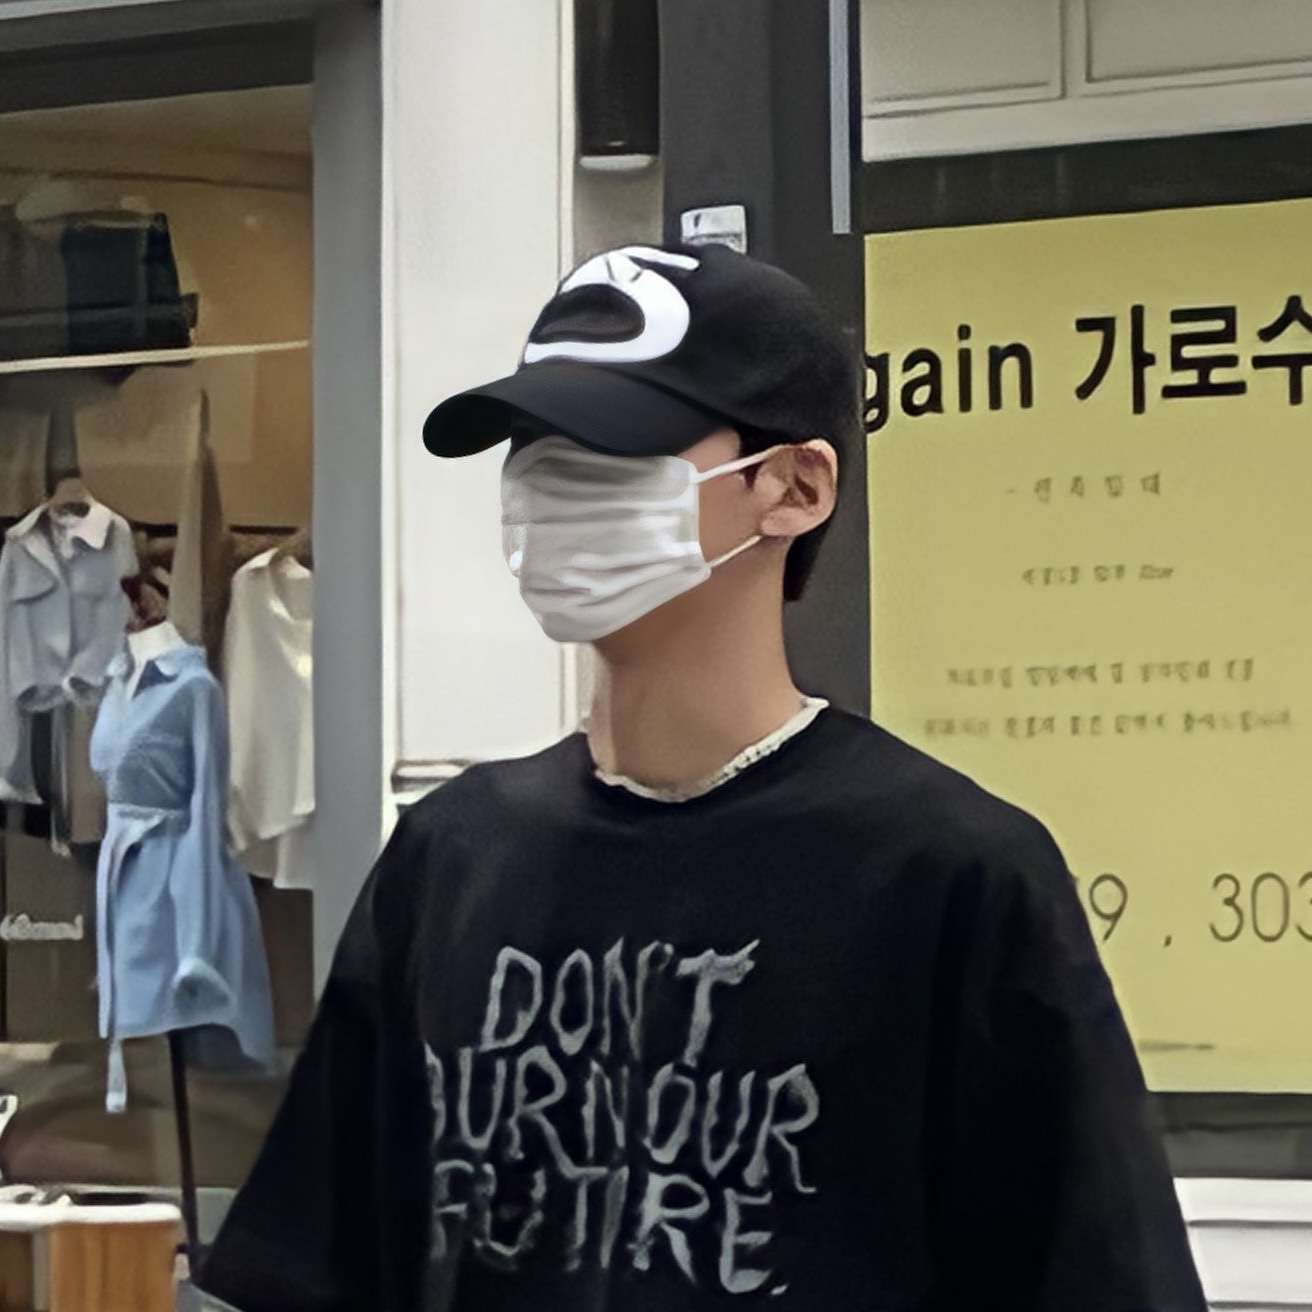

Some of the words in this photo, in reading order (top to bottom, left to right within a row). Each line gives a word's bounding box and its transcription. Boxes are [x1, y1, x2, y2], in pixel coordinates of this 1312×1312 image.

[479, 936, 760, 1067] DON'T
[424, 1040, 630, 1180] URN
[644, 1062, 821, 1194] OUR
